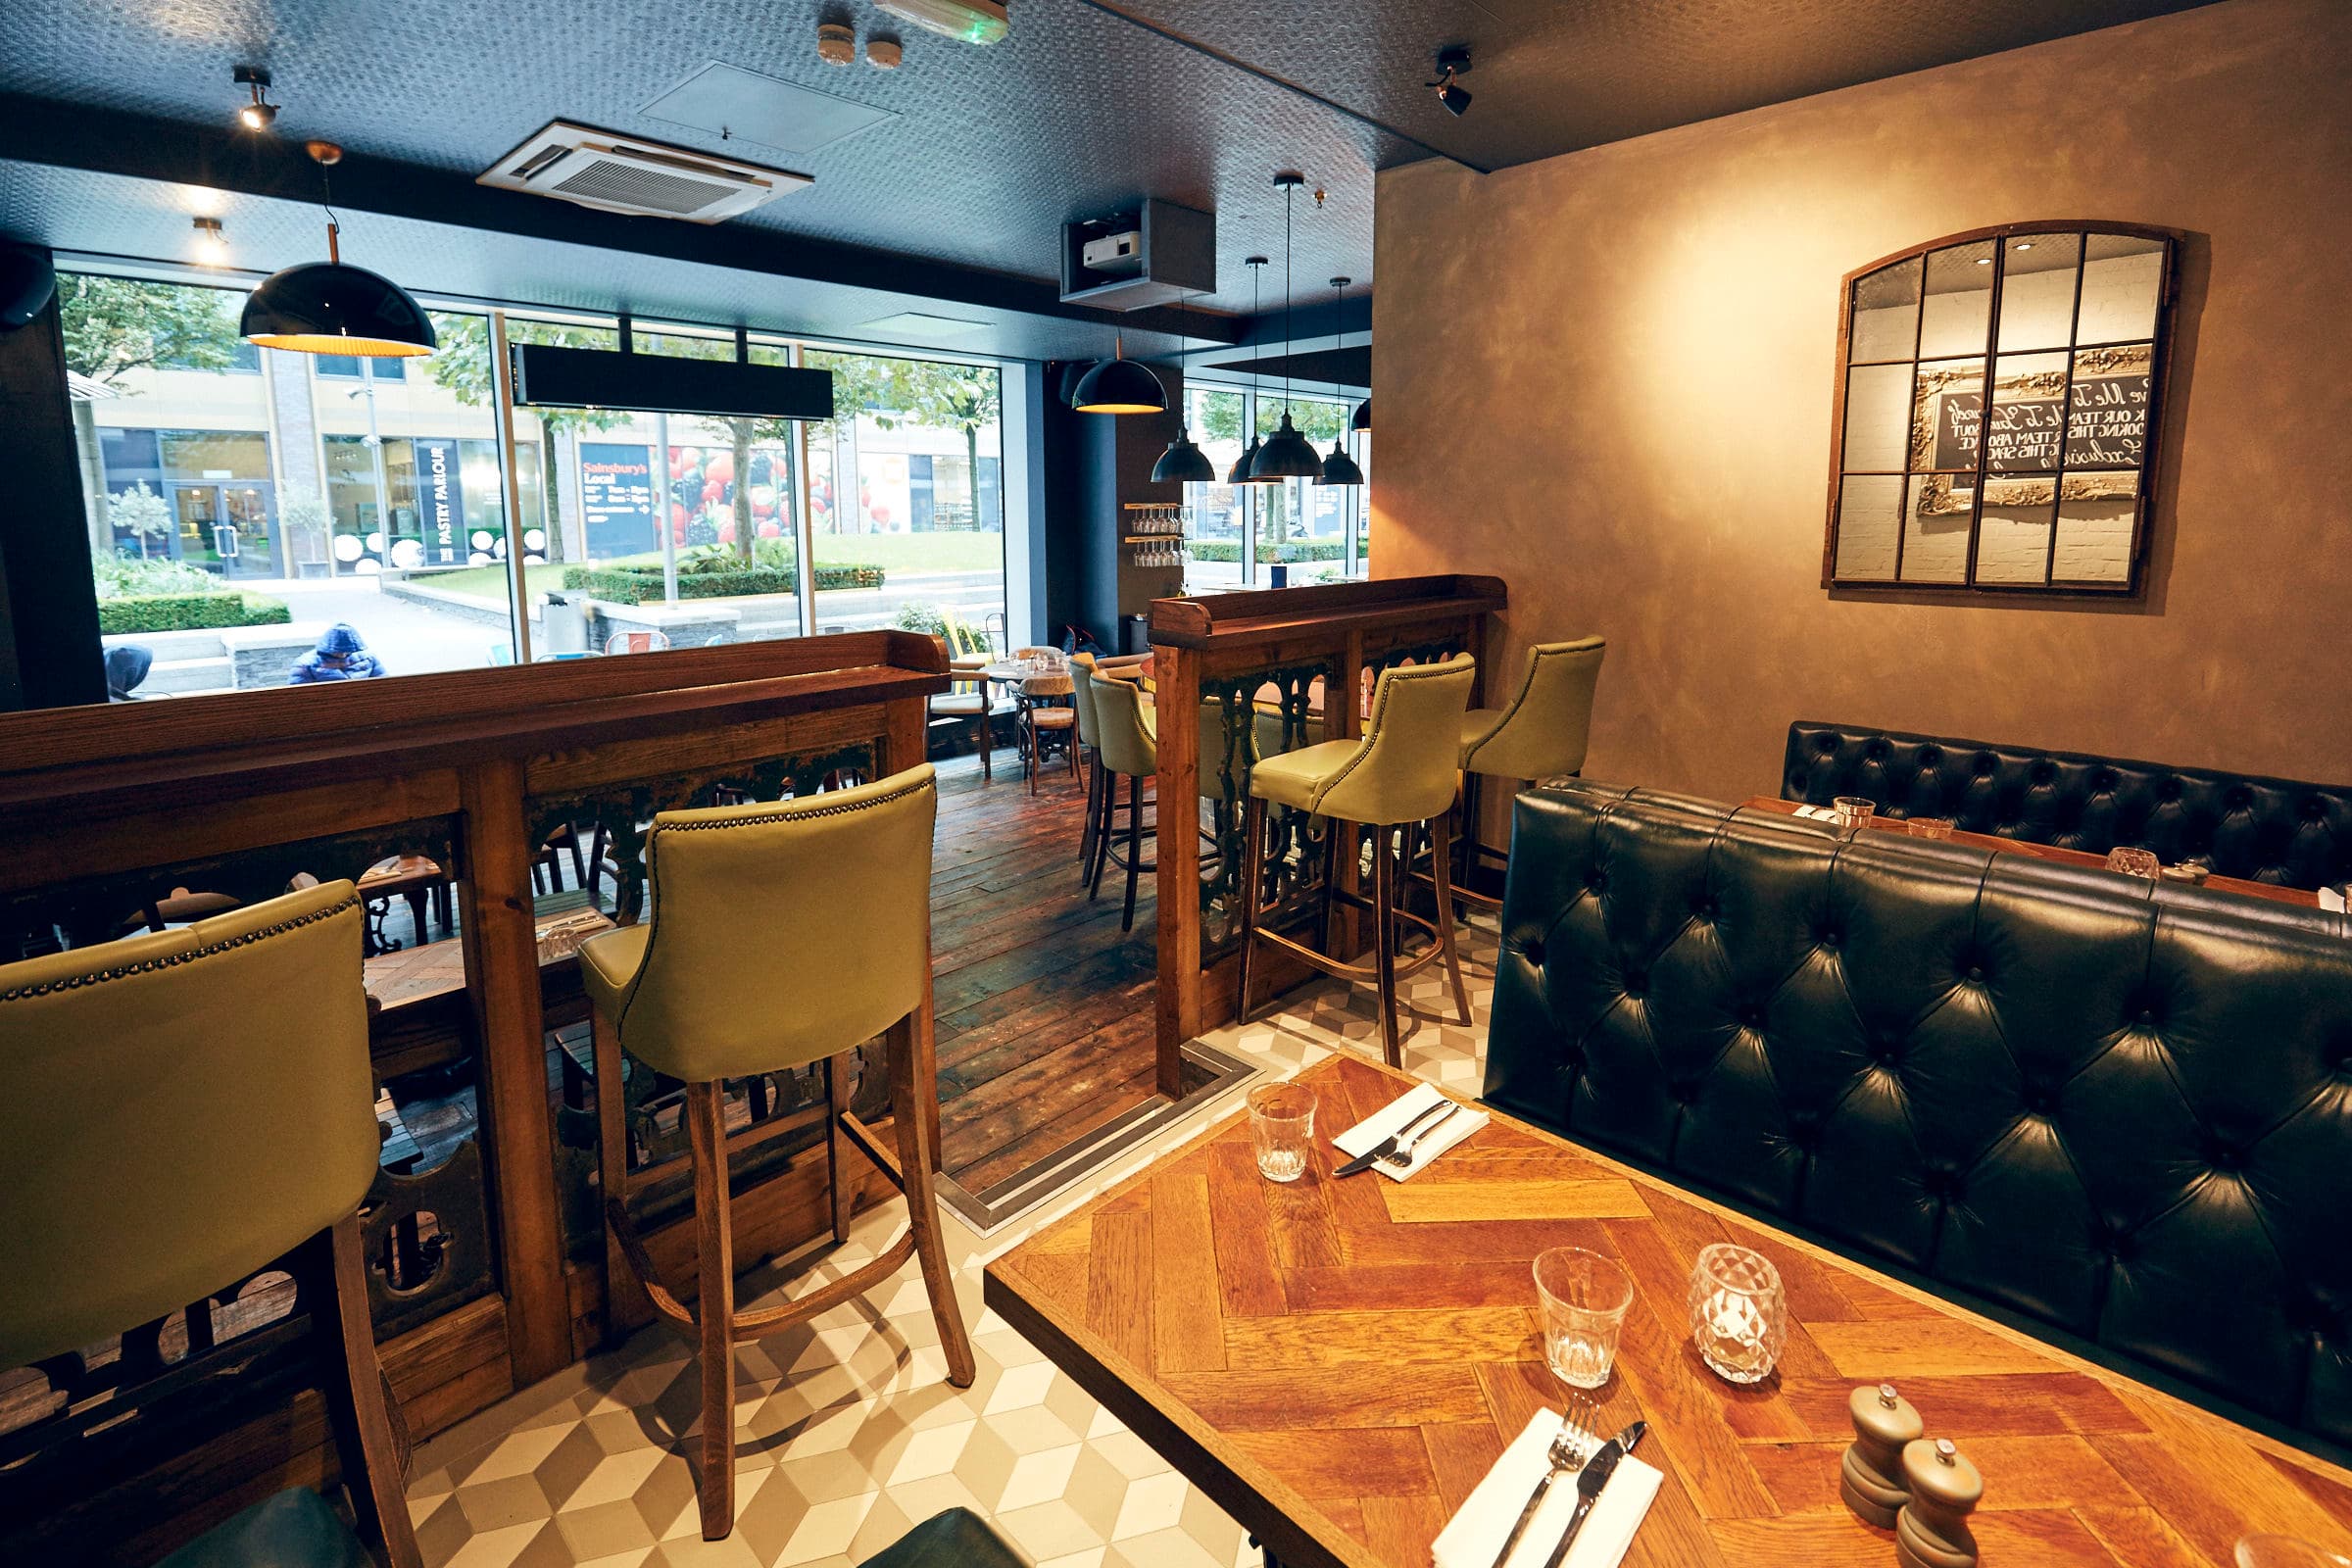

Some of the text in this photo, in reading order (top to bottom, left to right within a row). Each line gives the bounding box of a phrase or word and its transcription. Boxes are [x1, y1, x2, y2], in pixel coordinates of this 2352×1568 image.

[431, 447, 449, 501] PARLOUR
[583, 463, 648, 475] Sainsbury's
[583, 473, 616, 484] Local
[435, 502, 453, 545] PASTRY
